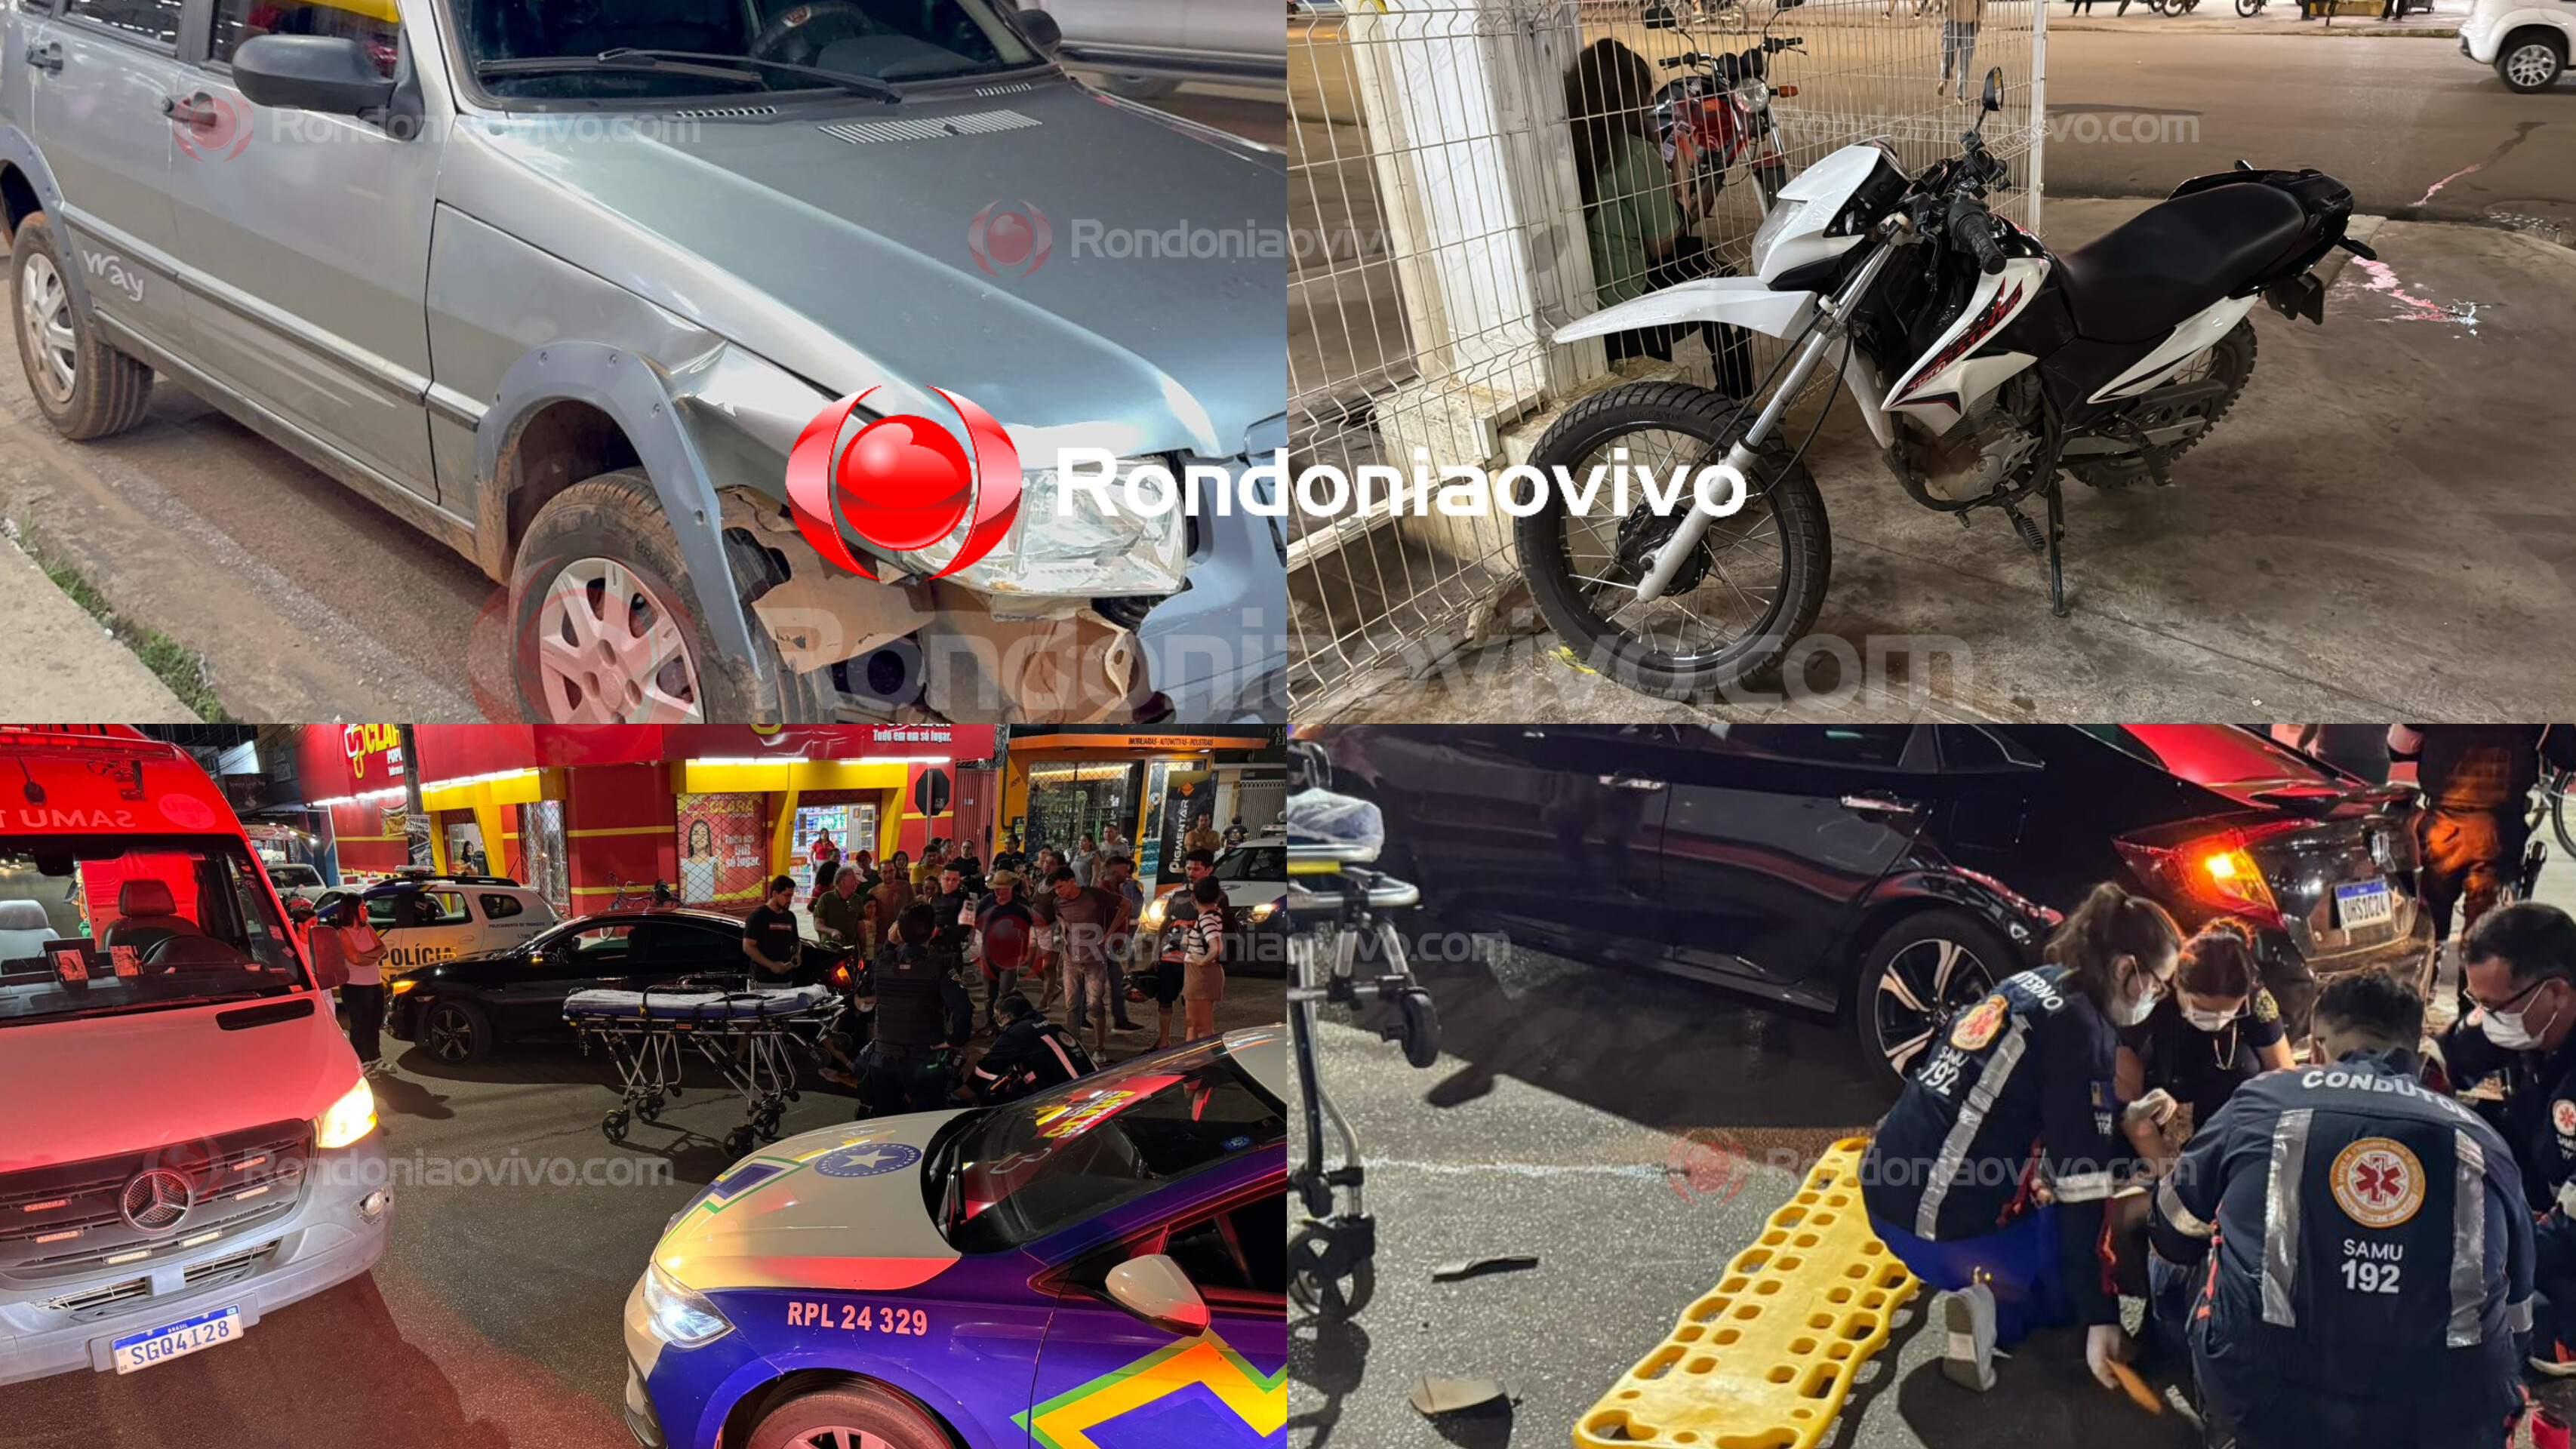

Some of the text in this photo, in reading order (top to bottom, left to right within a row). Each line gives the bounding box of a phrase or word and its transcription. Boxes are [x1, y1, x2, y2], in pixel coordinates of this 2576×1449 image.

[873, 729, 892, 741] Tudo
[893, 731, 906, 741] em
[906, 731, 919, 741] um
[920, 730, 930, 741] só
[1168, 799, 1189, 874] PIGMENTAR
[2343, 1238, 2403, 1262] SAMU
[2341, 1259, 2401, 1294] 192
[167, 1323, 189, 1334] BRASIL
[787, 1301, 928, 1336] RPL 24 329
